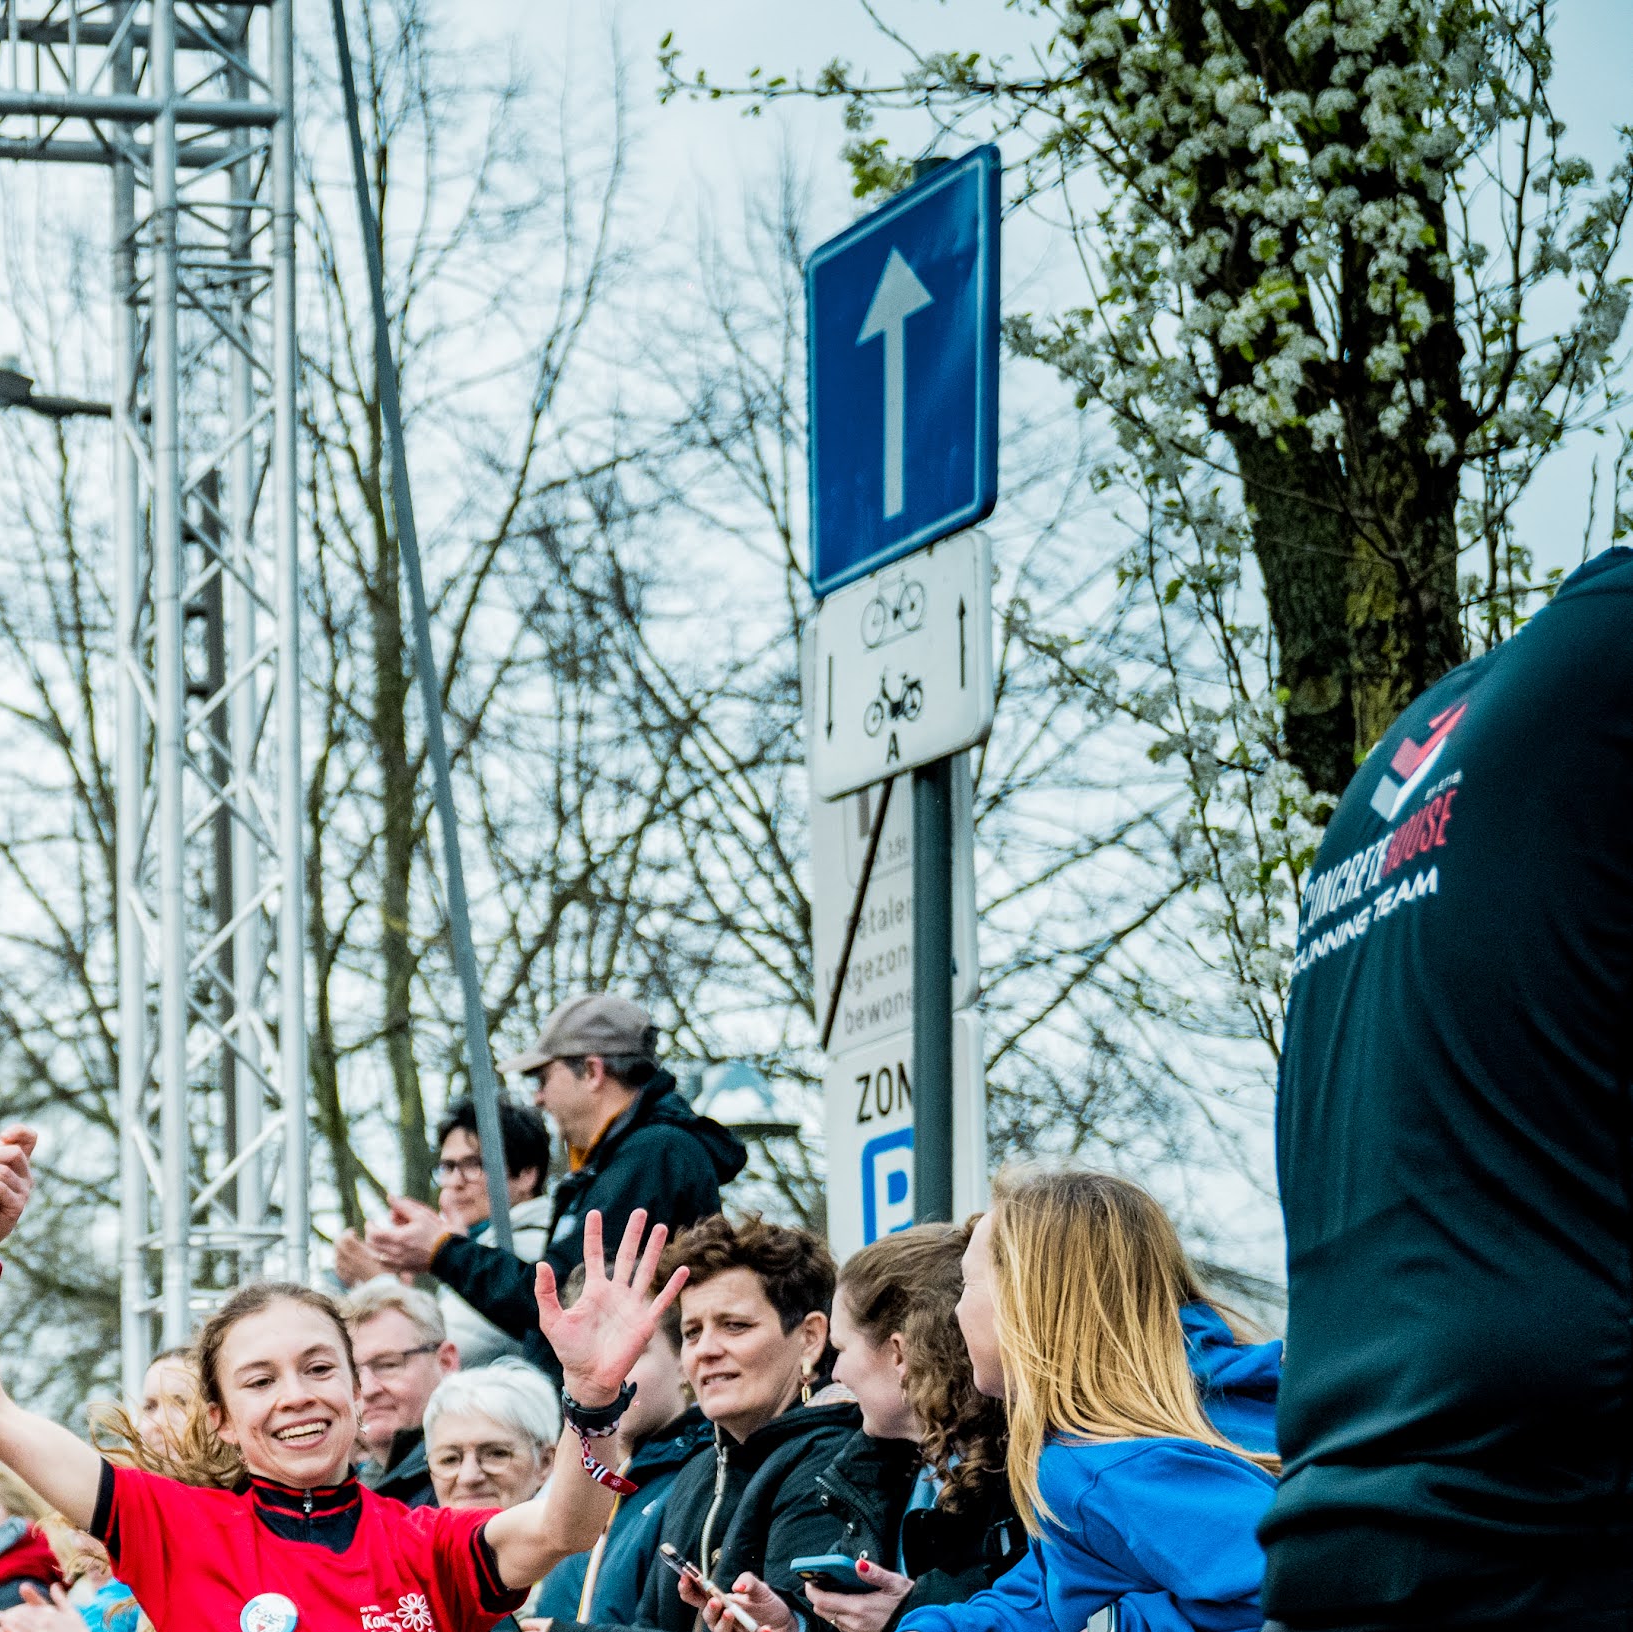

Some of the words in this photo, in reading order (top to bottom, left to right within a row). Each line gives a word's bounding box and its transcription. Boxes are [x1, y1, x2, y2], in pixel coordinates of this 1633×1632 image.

[886, 731, 900, 763] A
[1372, 864, 1439, 922] TEAM
[855, 1061, 913, 1125] ZON
